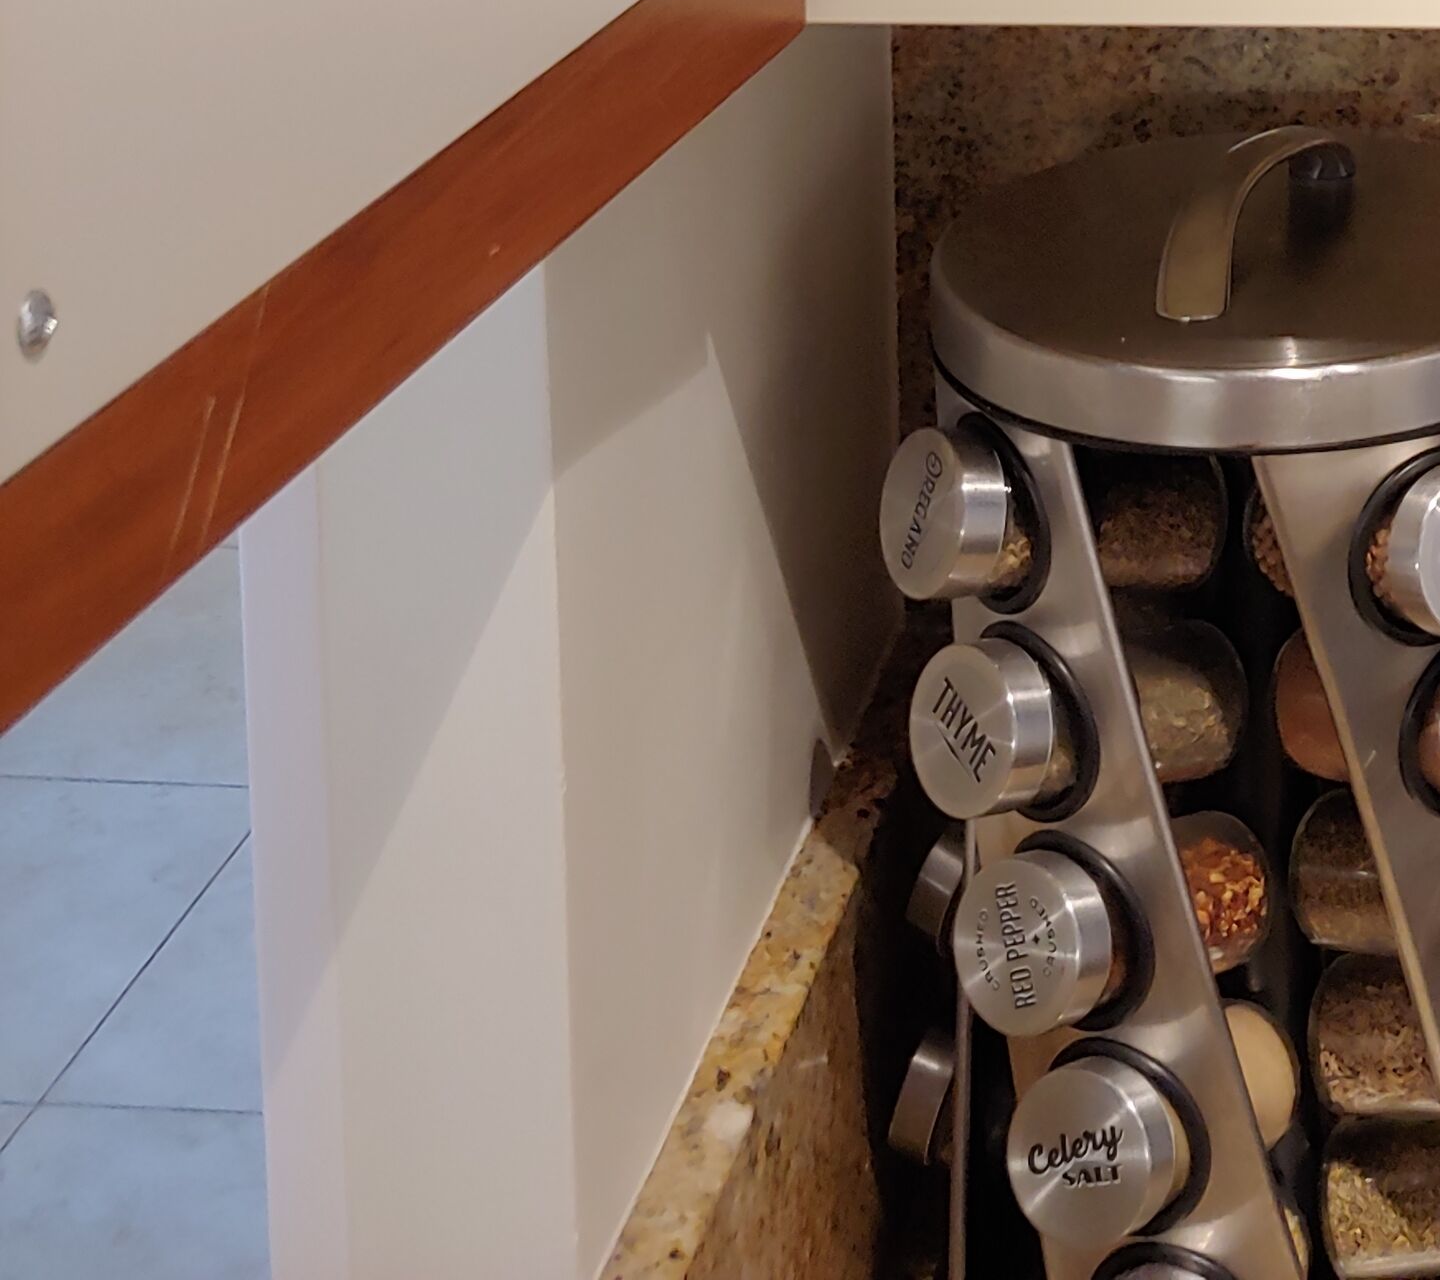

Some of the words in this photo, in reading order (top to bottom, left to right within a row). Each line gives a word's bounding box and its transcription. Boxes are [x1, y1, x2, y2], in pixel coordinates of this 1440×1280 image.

[901, 450, 943, 571] OREGANO
[931, 675, 997, 785] THYME
[975, 907, 1000, 992] CRUSHED
[994, 880, 1030, 963] PEPPER
[1009, 967, 1038, 1011] RED
[1027, 1124, 1125, 1175] Celery
[1061, 1163, 1123, 1188] SALT
